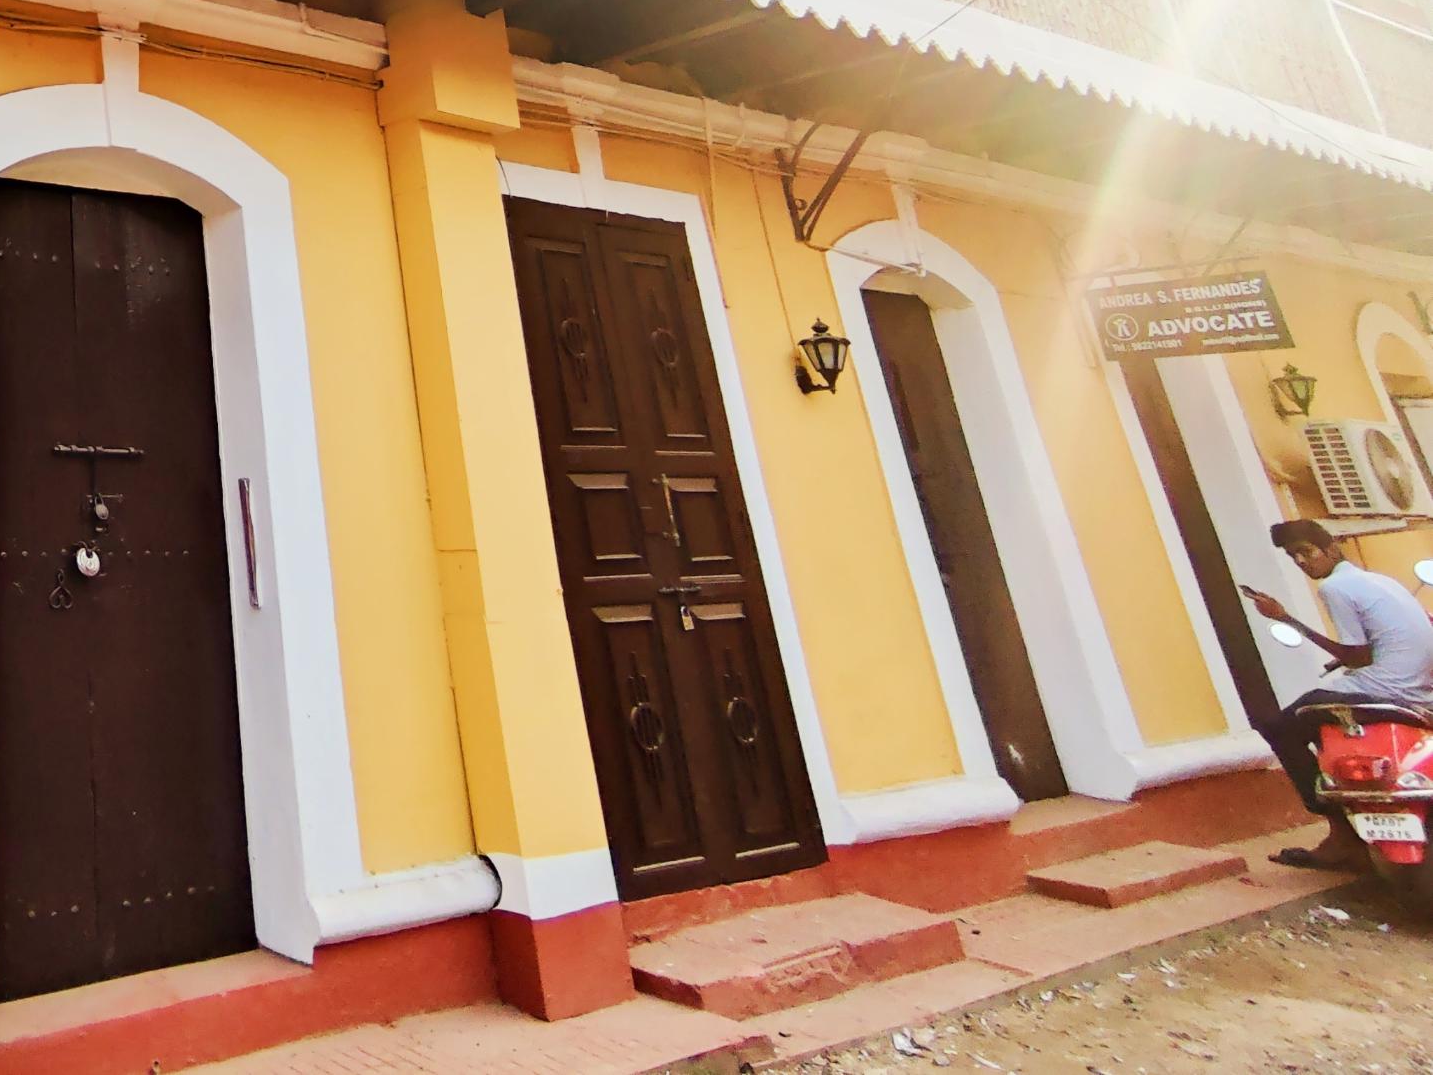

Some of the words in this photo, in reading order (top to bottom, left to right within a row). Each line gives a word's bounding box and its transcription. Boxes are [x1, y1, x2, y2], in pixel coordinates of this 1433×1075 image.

[1099, 292, 1153, 309] ANDREA
[1157, 290, 1172, 304] S.
[1174, 278, 1262, 302] FERNANDES
[1148, 310, 1275, 337] ADVOCATE
